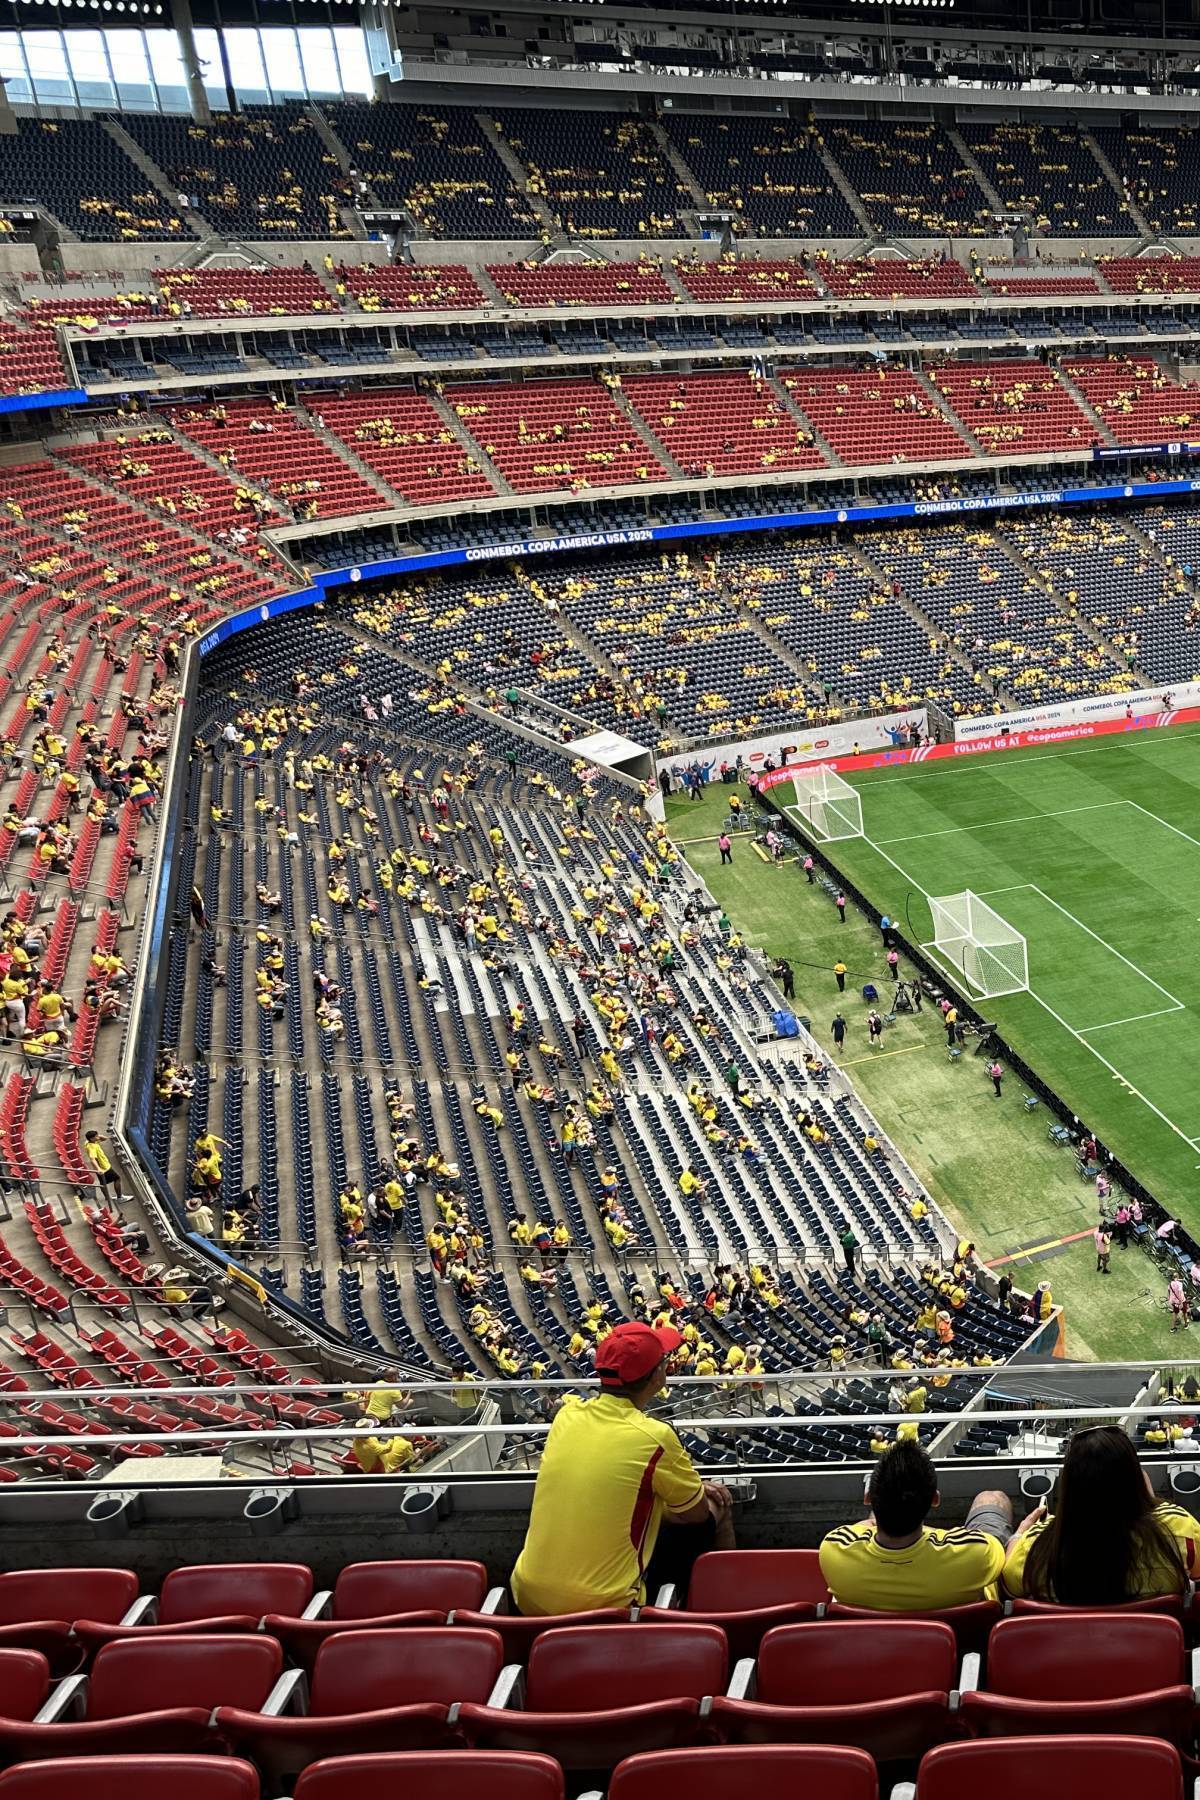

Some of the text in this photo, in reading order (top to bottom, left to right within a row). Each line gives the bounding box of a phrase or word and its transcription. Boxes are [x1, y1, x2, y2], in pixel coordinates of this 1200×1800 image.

[914, 493, 1060, 513] CONMEBOL COPA AMERICA USA 2024
[465, 530, 653, 561] CONMEBOL COPA AMERICA USA 2024
[1083, 702, 1114, 713] CONMEBOL
[1113, 698, 1128, 707] COPA
[1128, 695, 1152, 705] AMERICA
[960, 723, 994, 734] CONMEBOL
[993, 721, 1010, 729] COPA
[1009, 716, 1035, 727] AMERICA
[954, 726, 1094, 753] FOLLOW US AT @copaamerica
